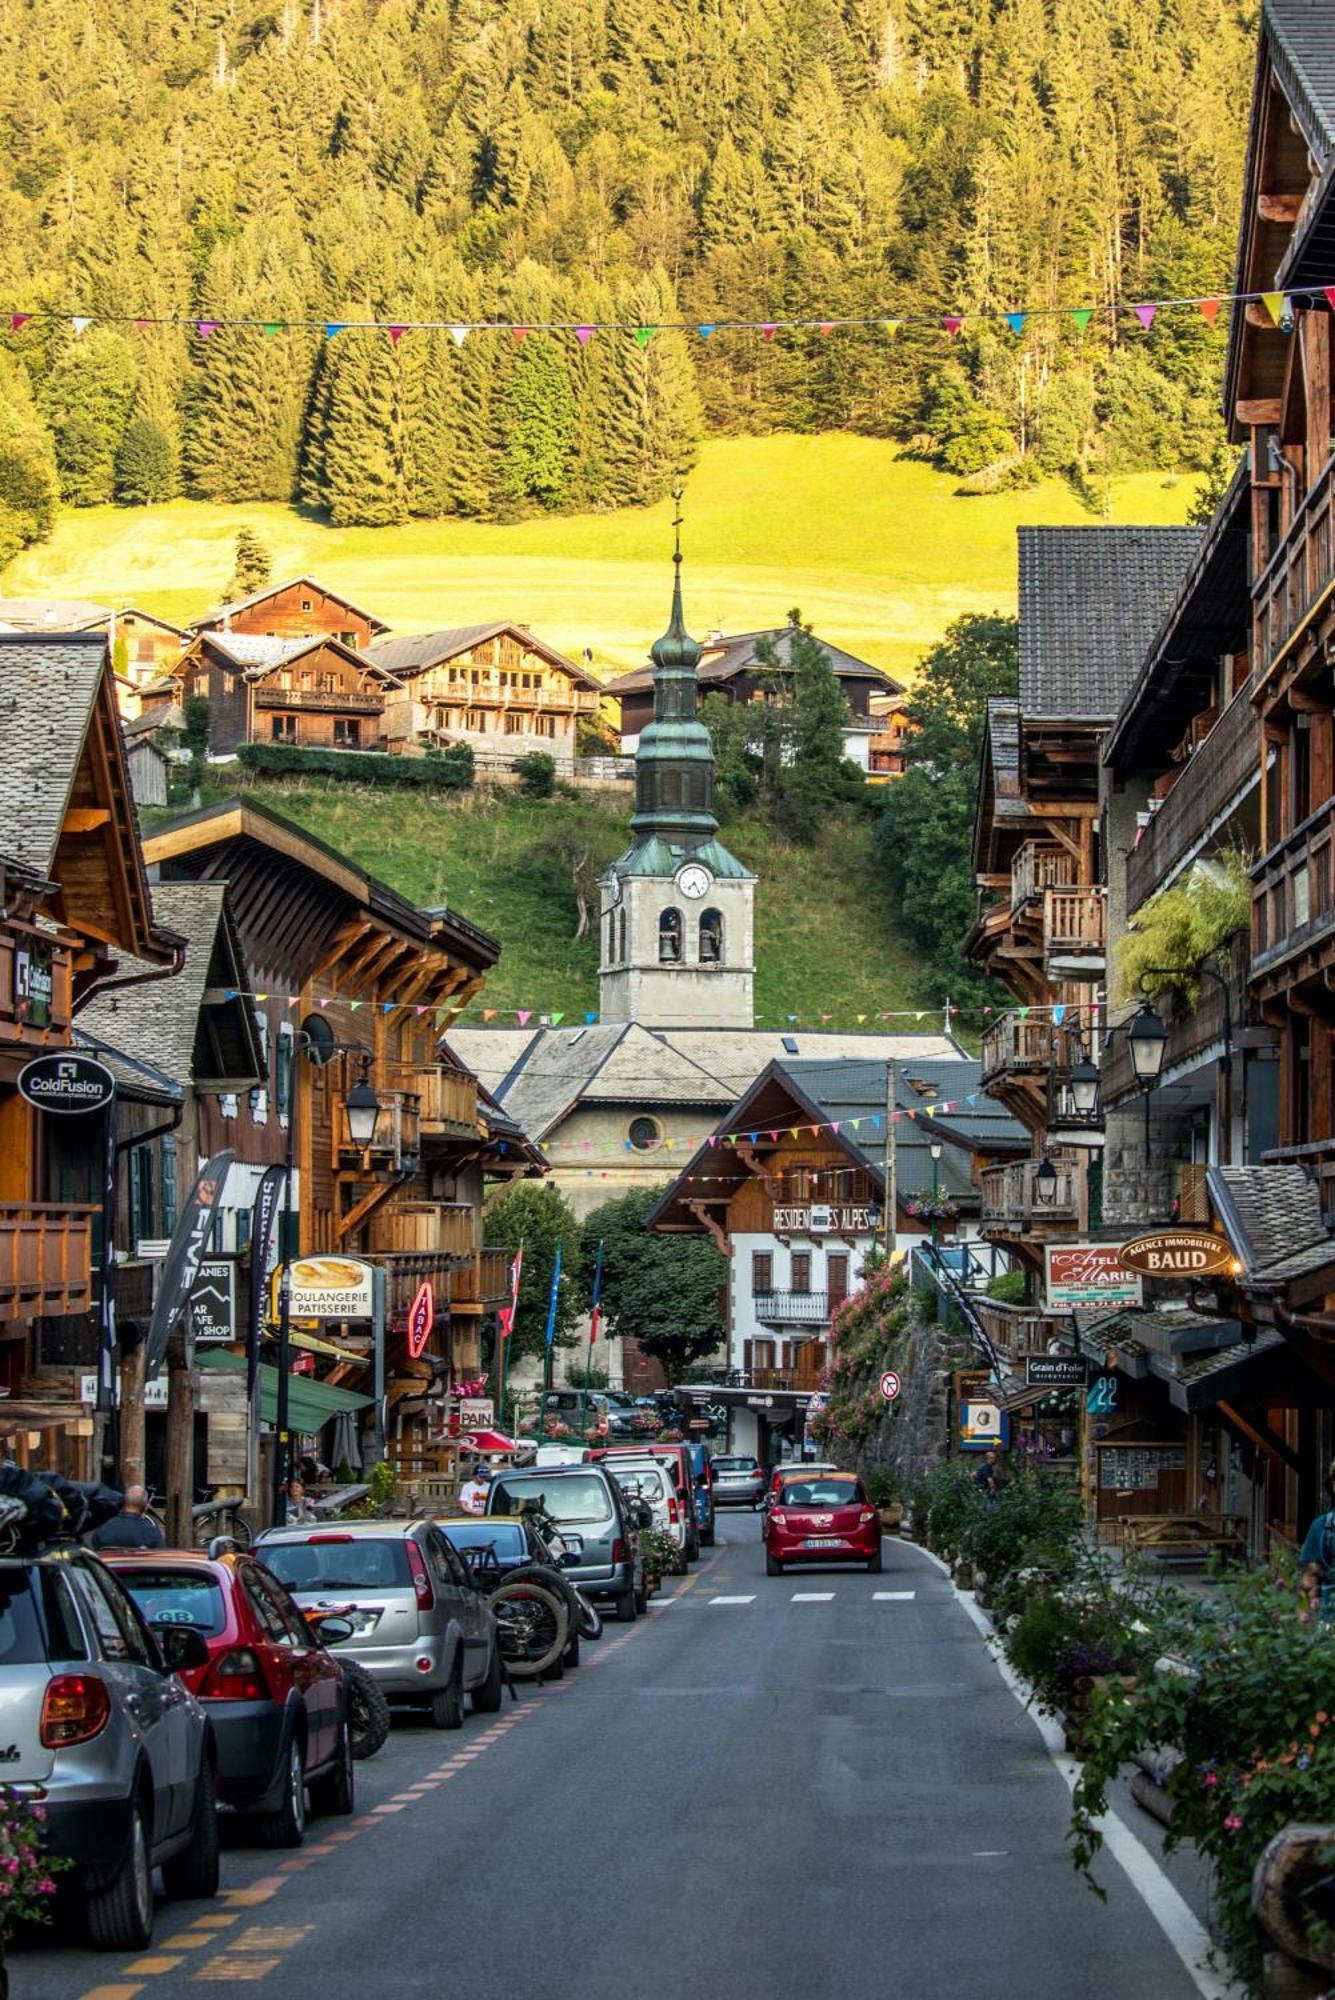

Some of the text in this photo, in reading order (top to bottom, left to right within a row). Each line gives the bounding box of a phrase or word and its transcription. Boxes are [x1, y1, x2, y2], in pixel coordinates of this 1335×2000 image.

[30, 1077, 103, 1094] ColdFusion
[773, 1208, 812, 1230] RESIDEN
[841, 1208, 870, 1230] ALPES
[180, 1208, 211, 1289] FIVE
[1130, 1239, 1163, 1257] AGENCE
[1148, 1251, 1207, 1270] BAUD
[198, 1267, 229, 1277] ANIES
[193, 1305, 208, 1314] AR
[298, 1303, 358, 1314] PATISSERIE
[414, 1296, 428, 1344] TABAC
[203, 1327, 230, 1336] SHOP
[1030, 1361, 1084, 1373] Grain d'Folie
[1097, 1377, 1118, 1407] 22
[462, 1412, 492, 1425] PAIN
[158, 1611, 189, 1622] GB
